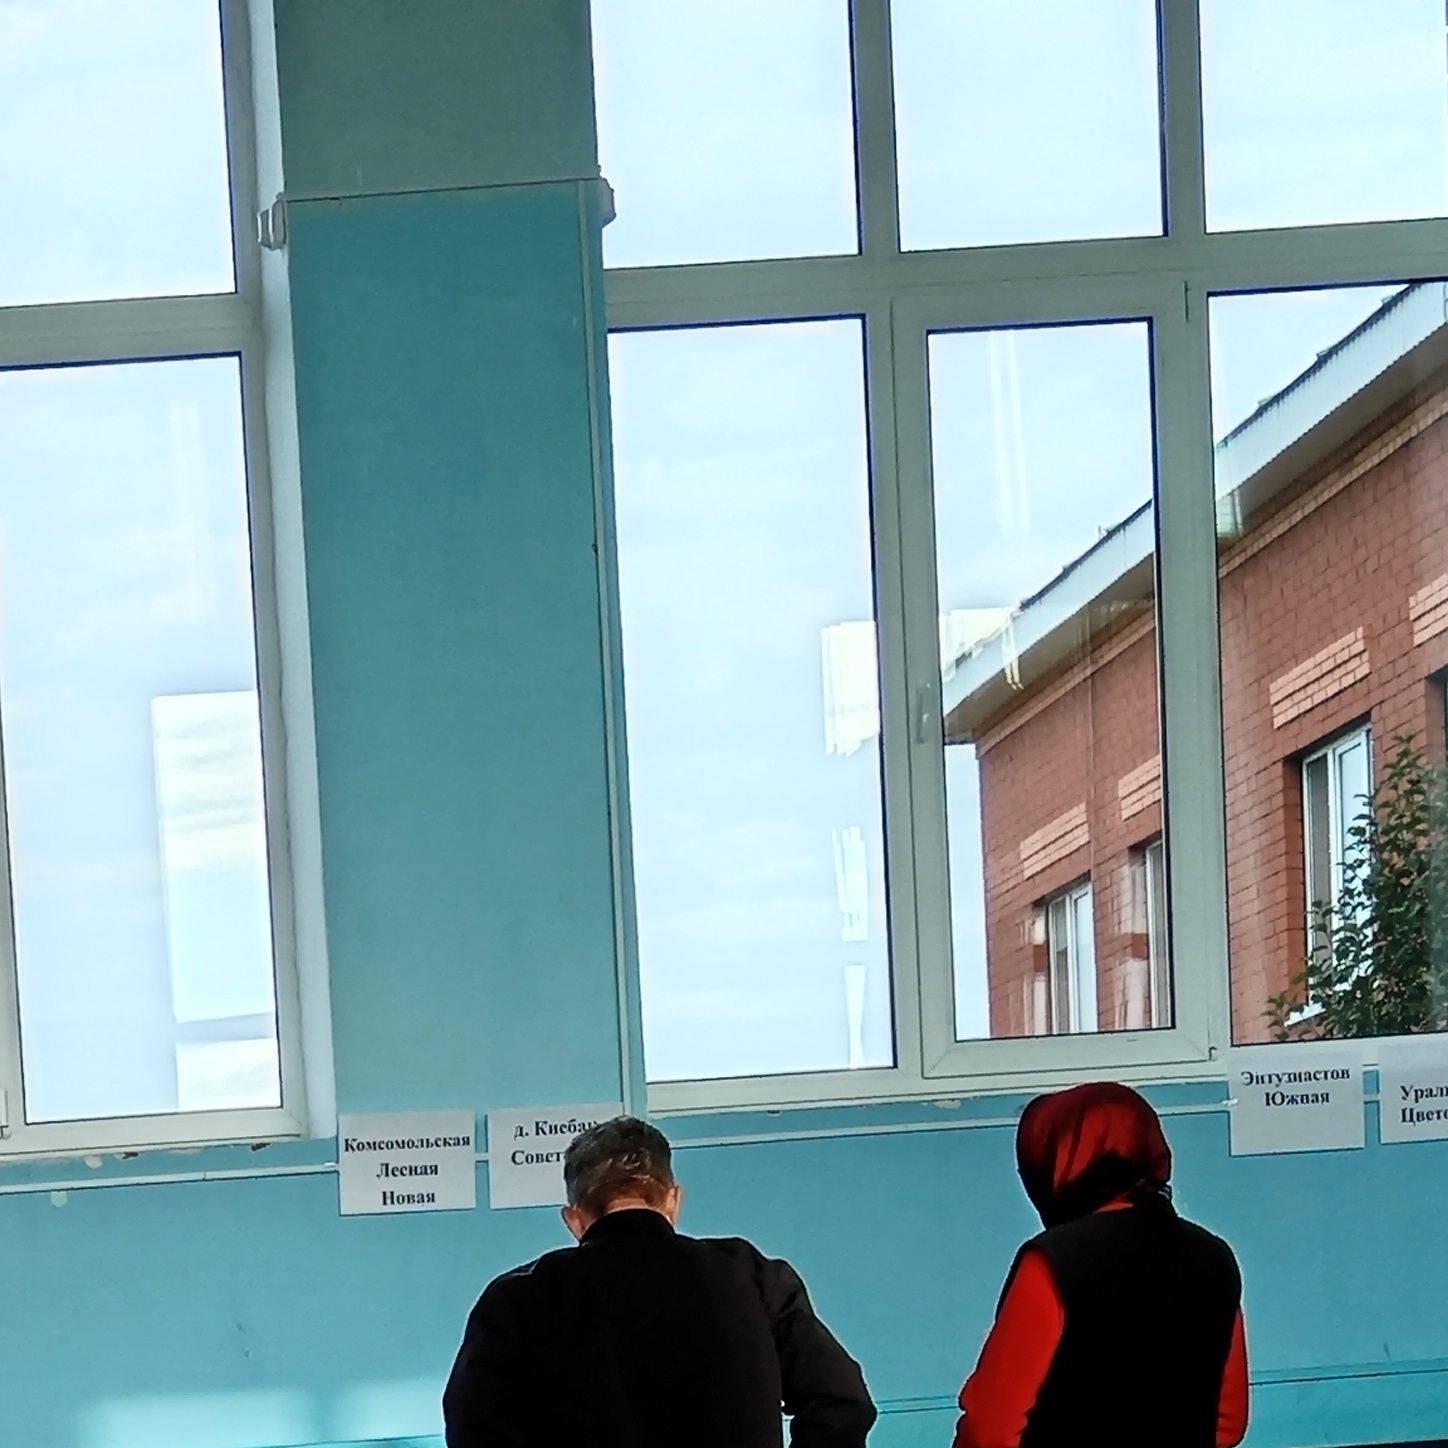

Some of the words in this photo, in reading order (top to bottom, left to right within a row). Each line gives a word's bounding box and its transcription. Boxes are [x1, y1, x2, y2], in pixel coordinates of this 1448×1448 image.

[1240, 1067, 1351, 1086] Энтузиастов
[1264, 1091, 1330, 1107] Южная
[513, 1124, 529, 1140] д.
[344, 1135, 471, 1153] Комсомольская
[511, 1150, 564, 1166] Совет
[376, 1161, 439, 1179] Лесная
[382, 1189, 436, 1206] Новая
